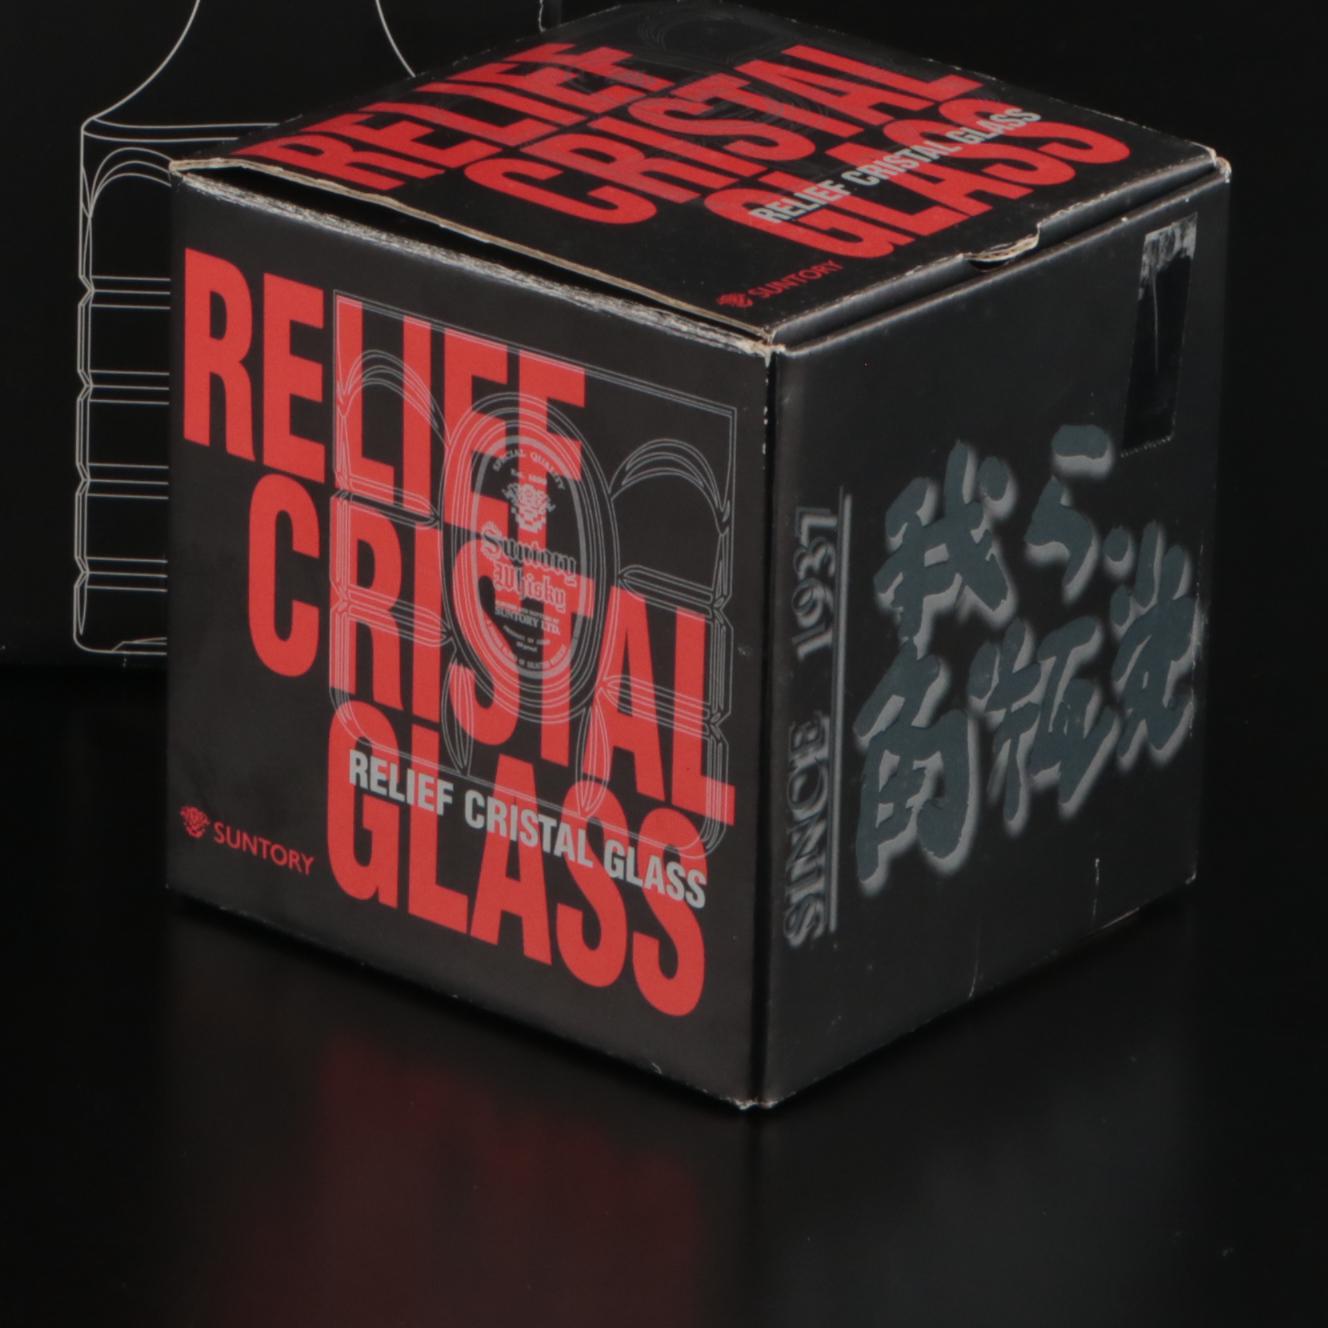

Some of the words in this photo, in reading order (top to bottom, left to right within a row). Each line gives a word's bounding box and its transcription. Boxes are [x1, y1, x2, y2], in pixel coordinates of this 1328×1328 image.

[229, 42, 676, 191] RELIEF
[463, 44, 984, 225] CRISTAL
[703, 97, 1132, 259] GLASS
[747, 180, 852, 224] RELIEF
[840, 139, 963, 187] CRISTAL
[945, 107, 1042, 146] GLASS
[746, 259, 845, 301] SUNTORY
[184, 247, 586, 549] RELIEF
[480, 521, 577, 588] Suntory
[493, 562, 567, 613] Whisky
[791, 506, 839, 661] 1937
[248, 473, 735, 826] CRISTAL
[213, 820, 314, 876] SUNTORY
[326, 698, 709, 1017] GLASS
[348, 749, 453, 817] RELIEF
[464, 789, 593, 868] CRISTAL
[604, 838, 708, 910] GLASS
[784, 712, 830, 948] SINCE
